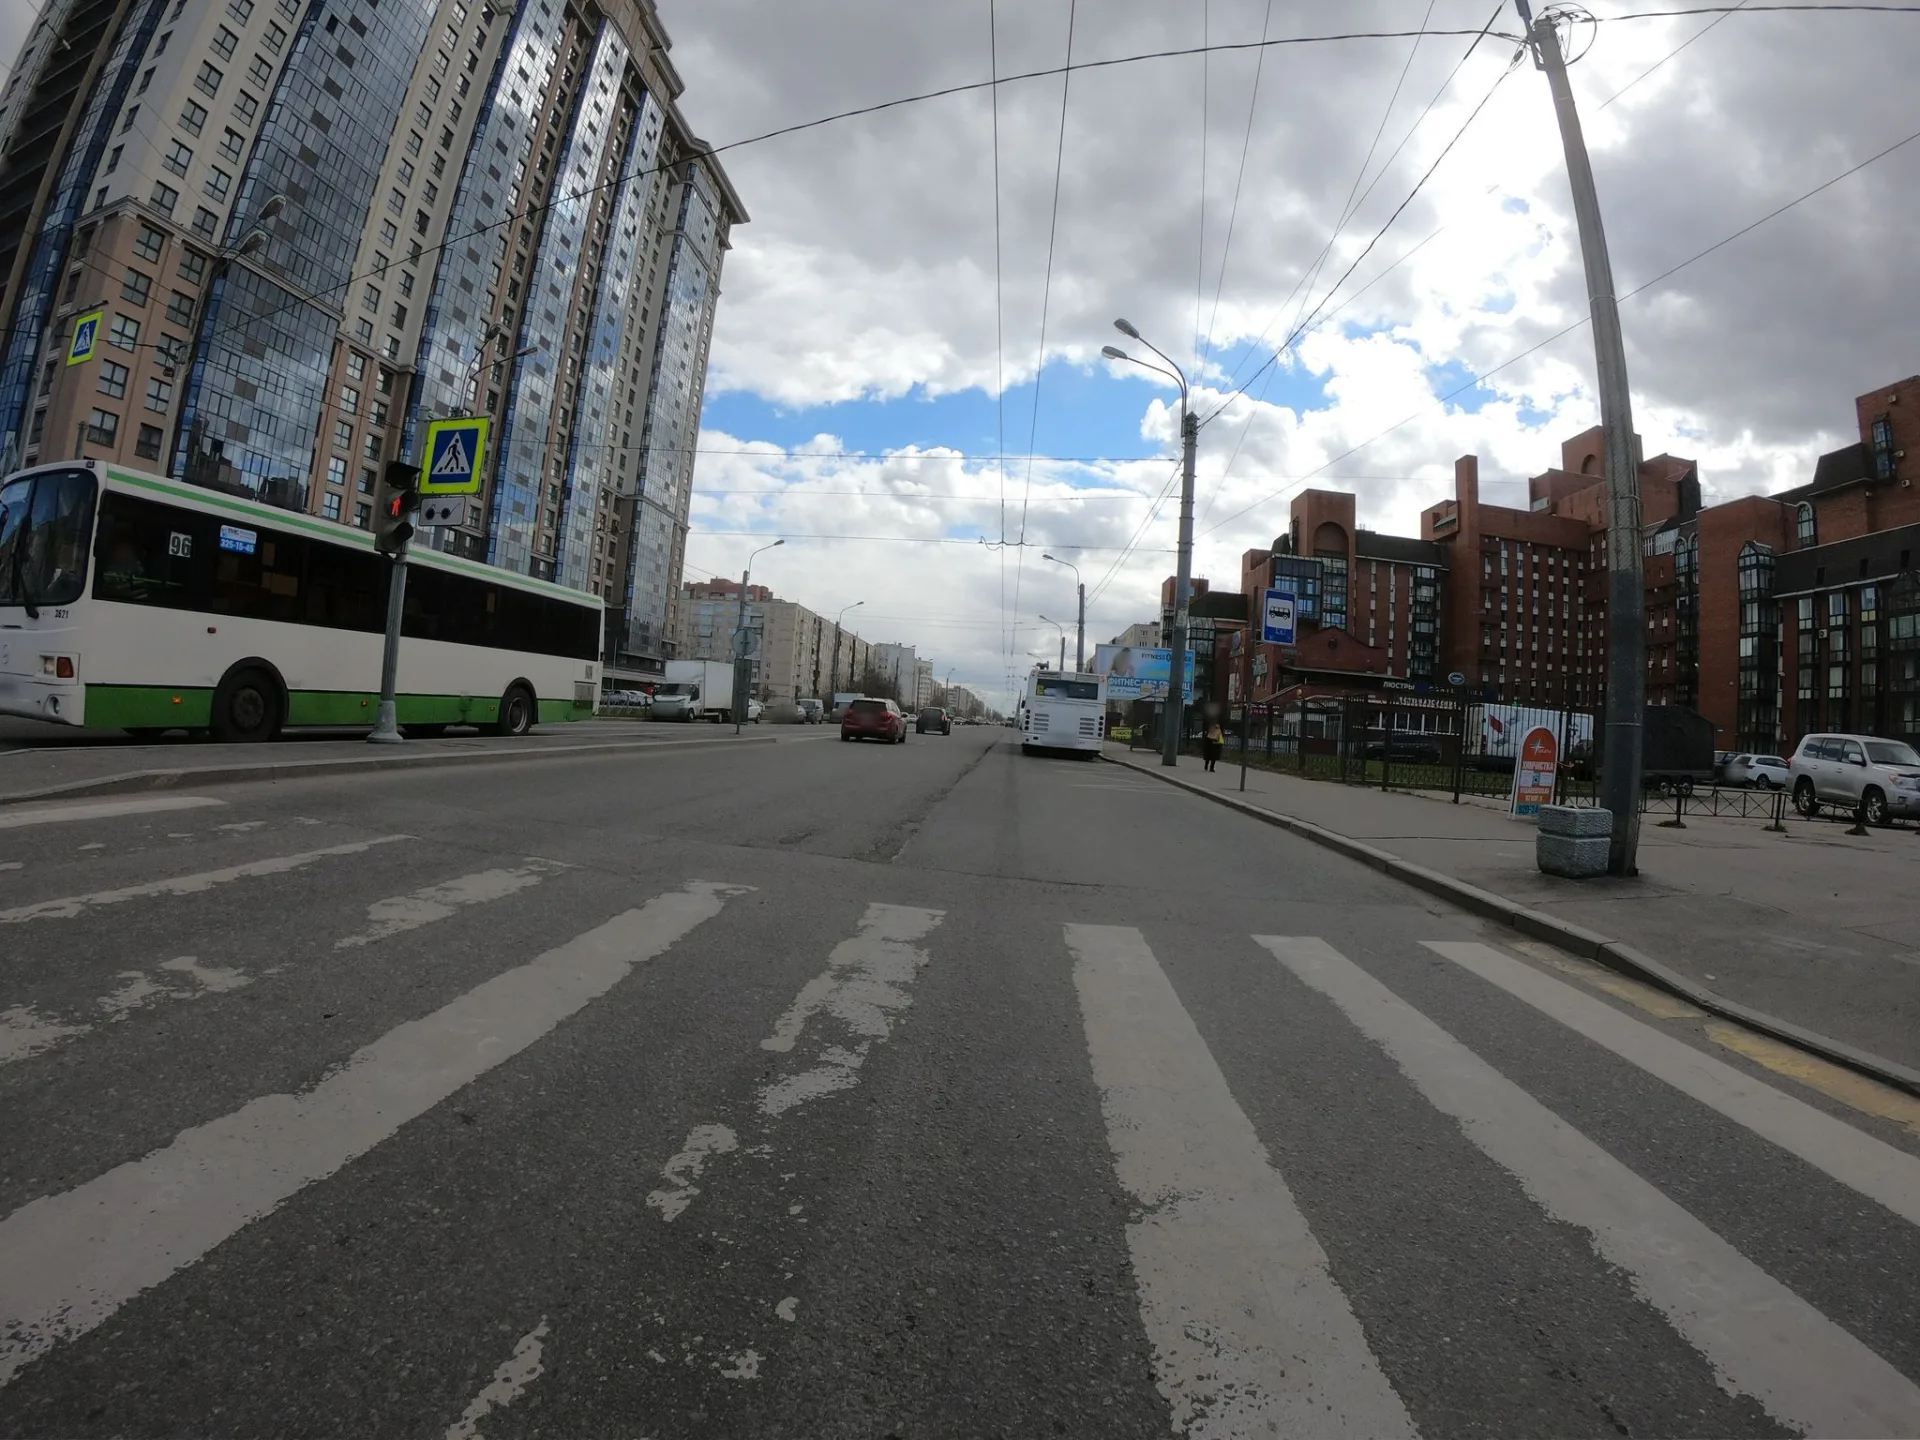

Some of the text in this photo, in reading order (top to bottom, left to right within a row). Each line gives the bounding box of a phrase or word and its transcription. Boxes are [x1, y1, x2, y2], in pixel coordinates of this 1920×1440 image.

[171, 536, 192, 556] 96
[220, 538, 254, 552] 325-15-45
[1141, 653, 1165, 661] FITNESS
[1108, 677, 1141, 688] ФИТНЕС
[1383, 681, 1415, 691] ЛЮСТРЫ
[1522, 760, 1553, 771] ХИМЧИСТКА
